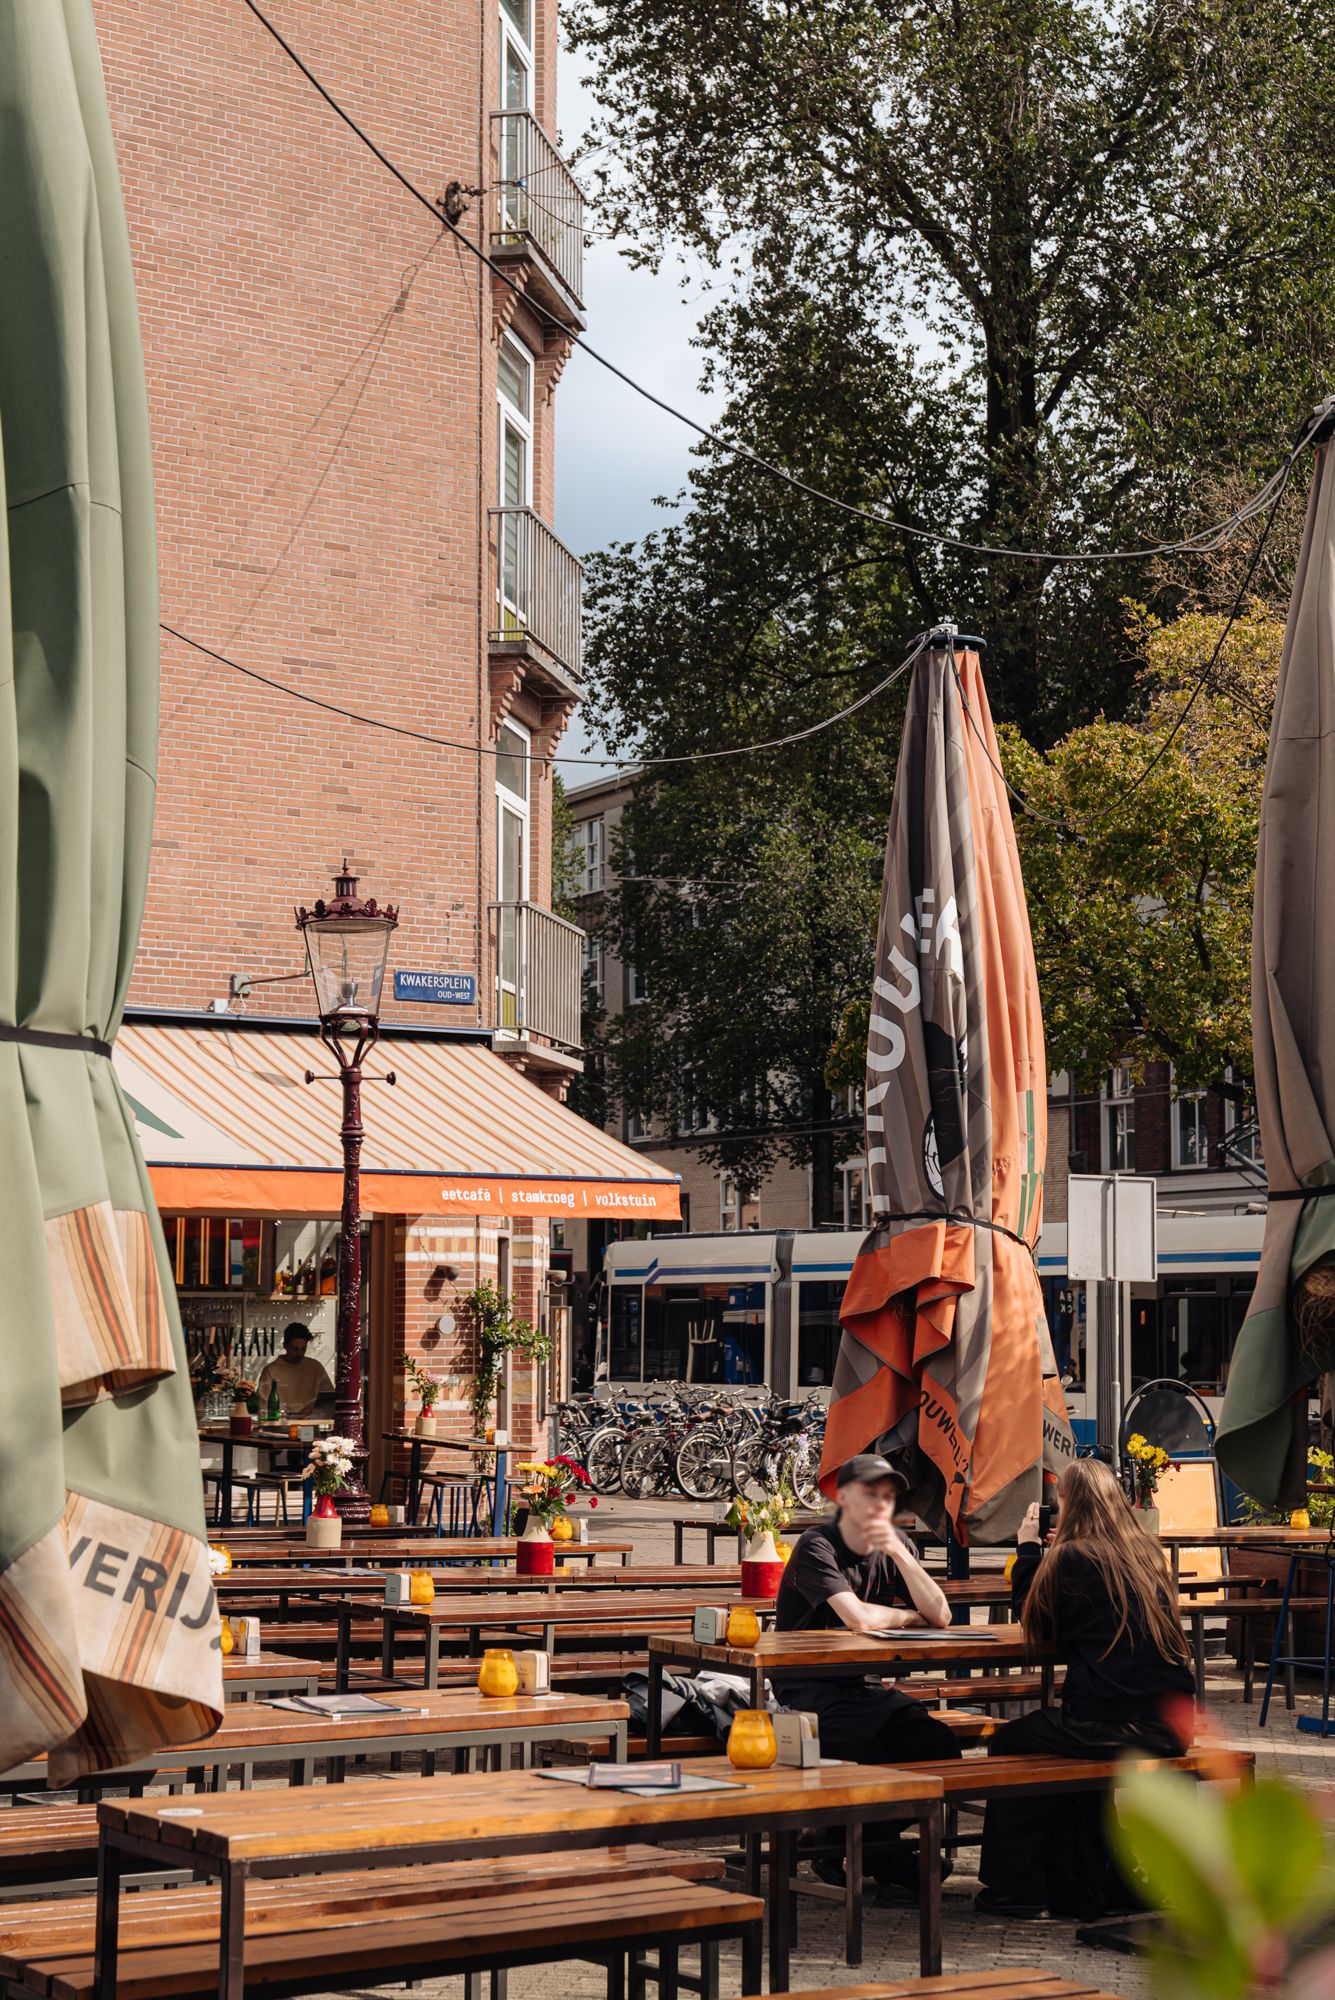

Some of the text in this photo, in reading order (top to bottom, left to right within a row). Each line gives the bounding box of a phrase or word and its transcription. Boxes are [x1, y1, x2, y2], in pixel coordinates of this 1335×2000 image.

[400, 974, 471, 990] KWAKERSPLEIN
[437, 990, 470, 1000] OUD-WEST
[441, 1187, 657, 1207] eetcafé stamkroeg volkstuin
[70, 1536, 217, 1630] ERIJ
